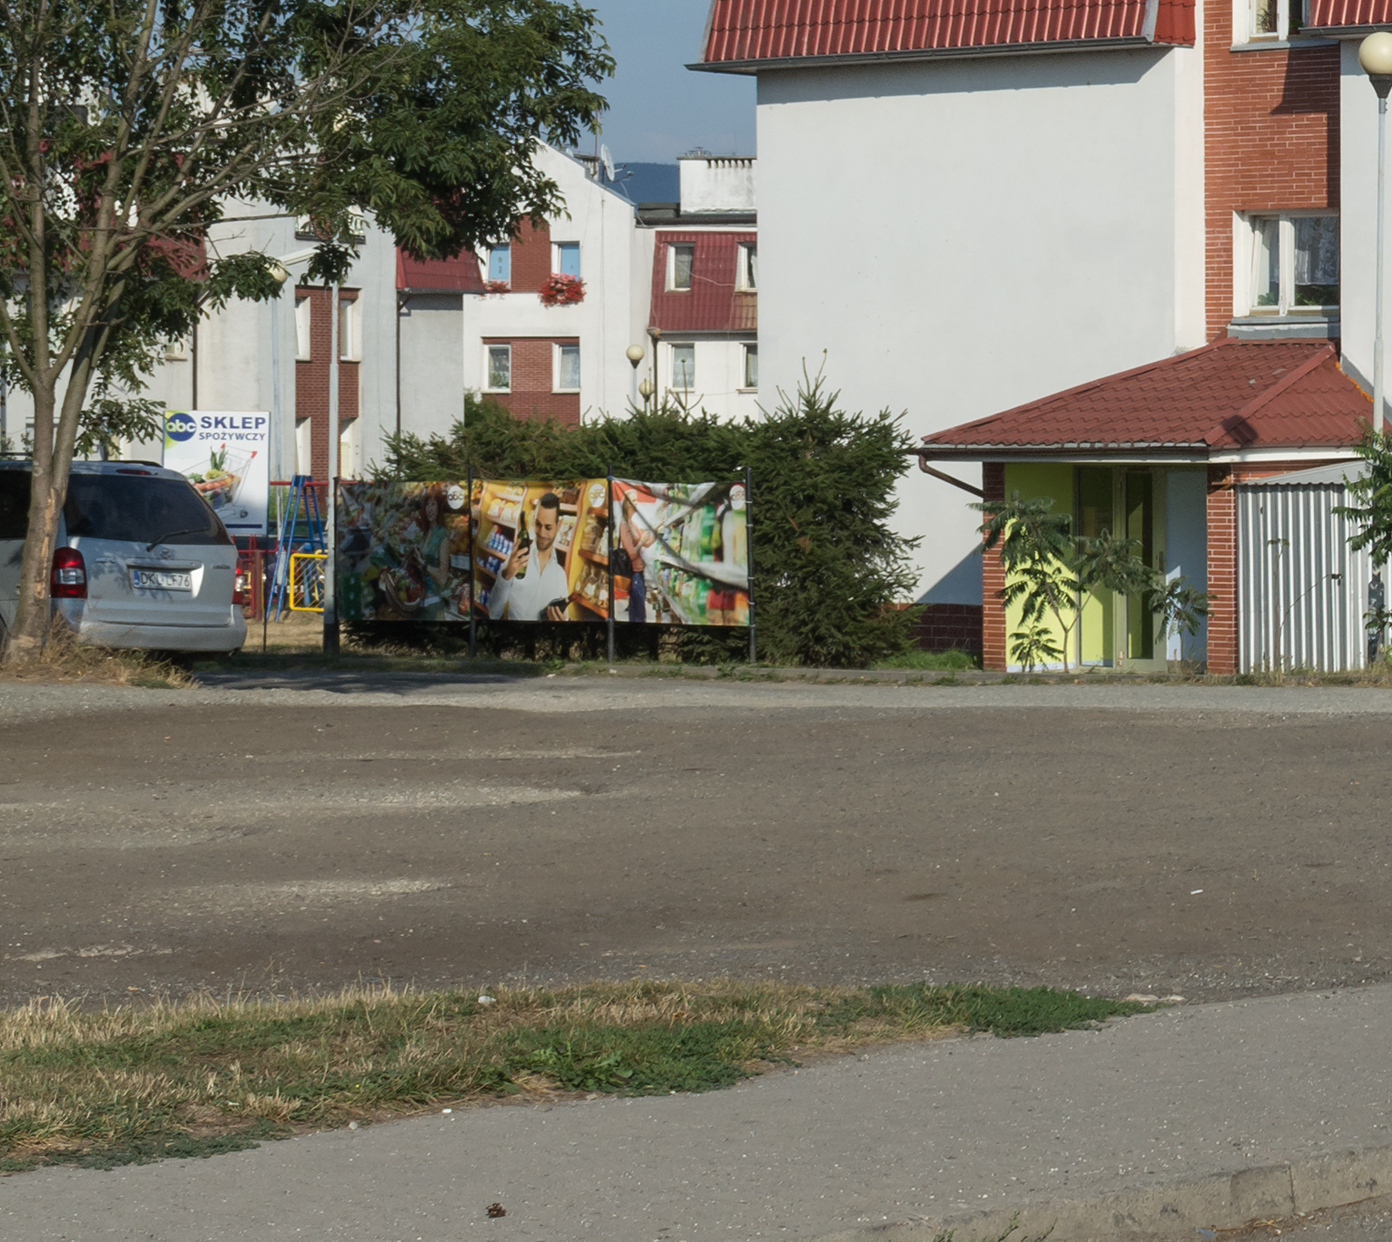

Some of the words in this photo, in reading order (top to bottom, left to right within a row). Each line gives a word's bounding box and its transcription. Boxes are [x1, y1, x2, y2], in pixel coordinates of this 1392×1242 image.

[166, 419, 197, 433] abc
[200, 416, 266, 429] SKLEP
[199, 431, 265, 441] SPOŻYWCZY
